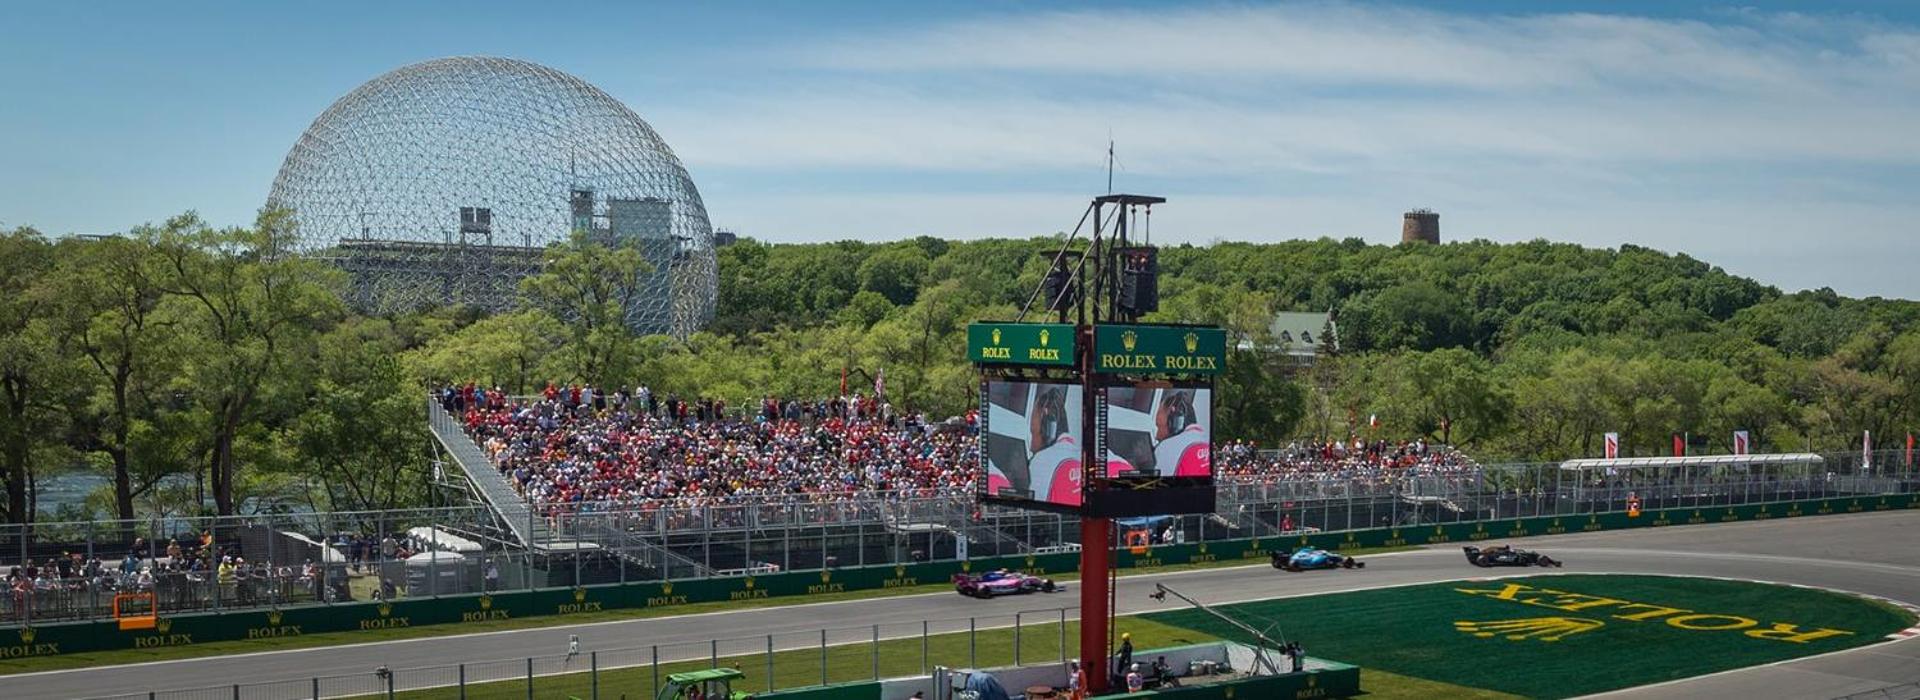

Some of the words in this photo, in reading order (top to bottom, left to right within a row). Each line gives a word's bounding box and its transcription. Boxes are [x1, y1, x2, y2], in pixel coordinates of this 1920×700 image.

[982, 347, 1011, 359] ROLEX
[1029, 348, 1060, 361] ROLEX
[1102, 354, 1157, 369] ROLEX
[1165, 355, 1217, 370] ROLEX
[648, 595, 688, 606] ROLEX
[731, 588, 768, 600] ROLEX
[558, 601, 602, 614] ROLEX
[1454, 583, 1856, 643] ROLEX
[463, 609, 510, 623] ROLEX
[360, 617, 409, 630] ROLEX
[248, 625, 301, 639] ROLEX
[135, 633, 192, 649] ROLEX
[0, 642, 60, 659] ROLEX
